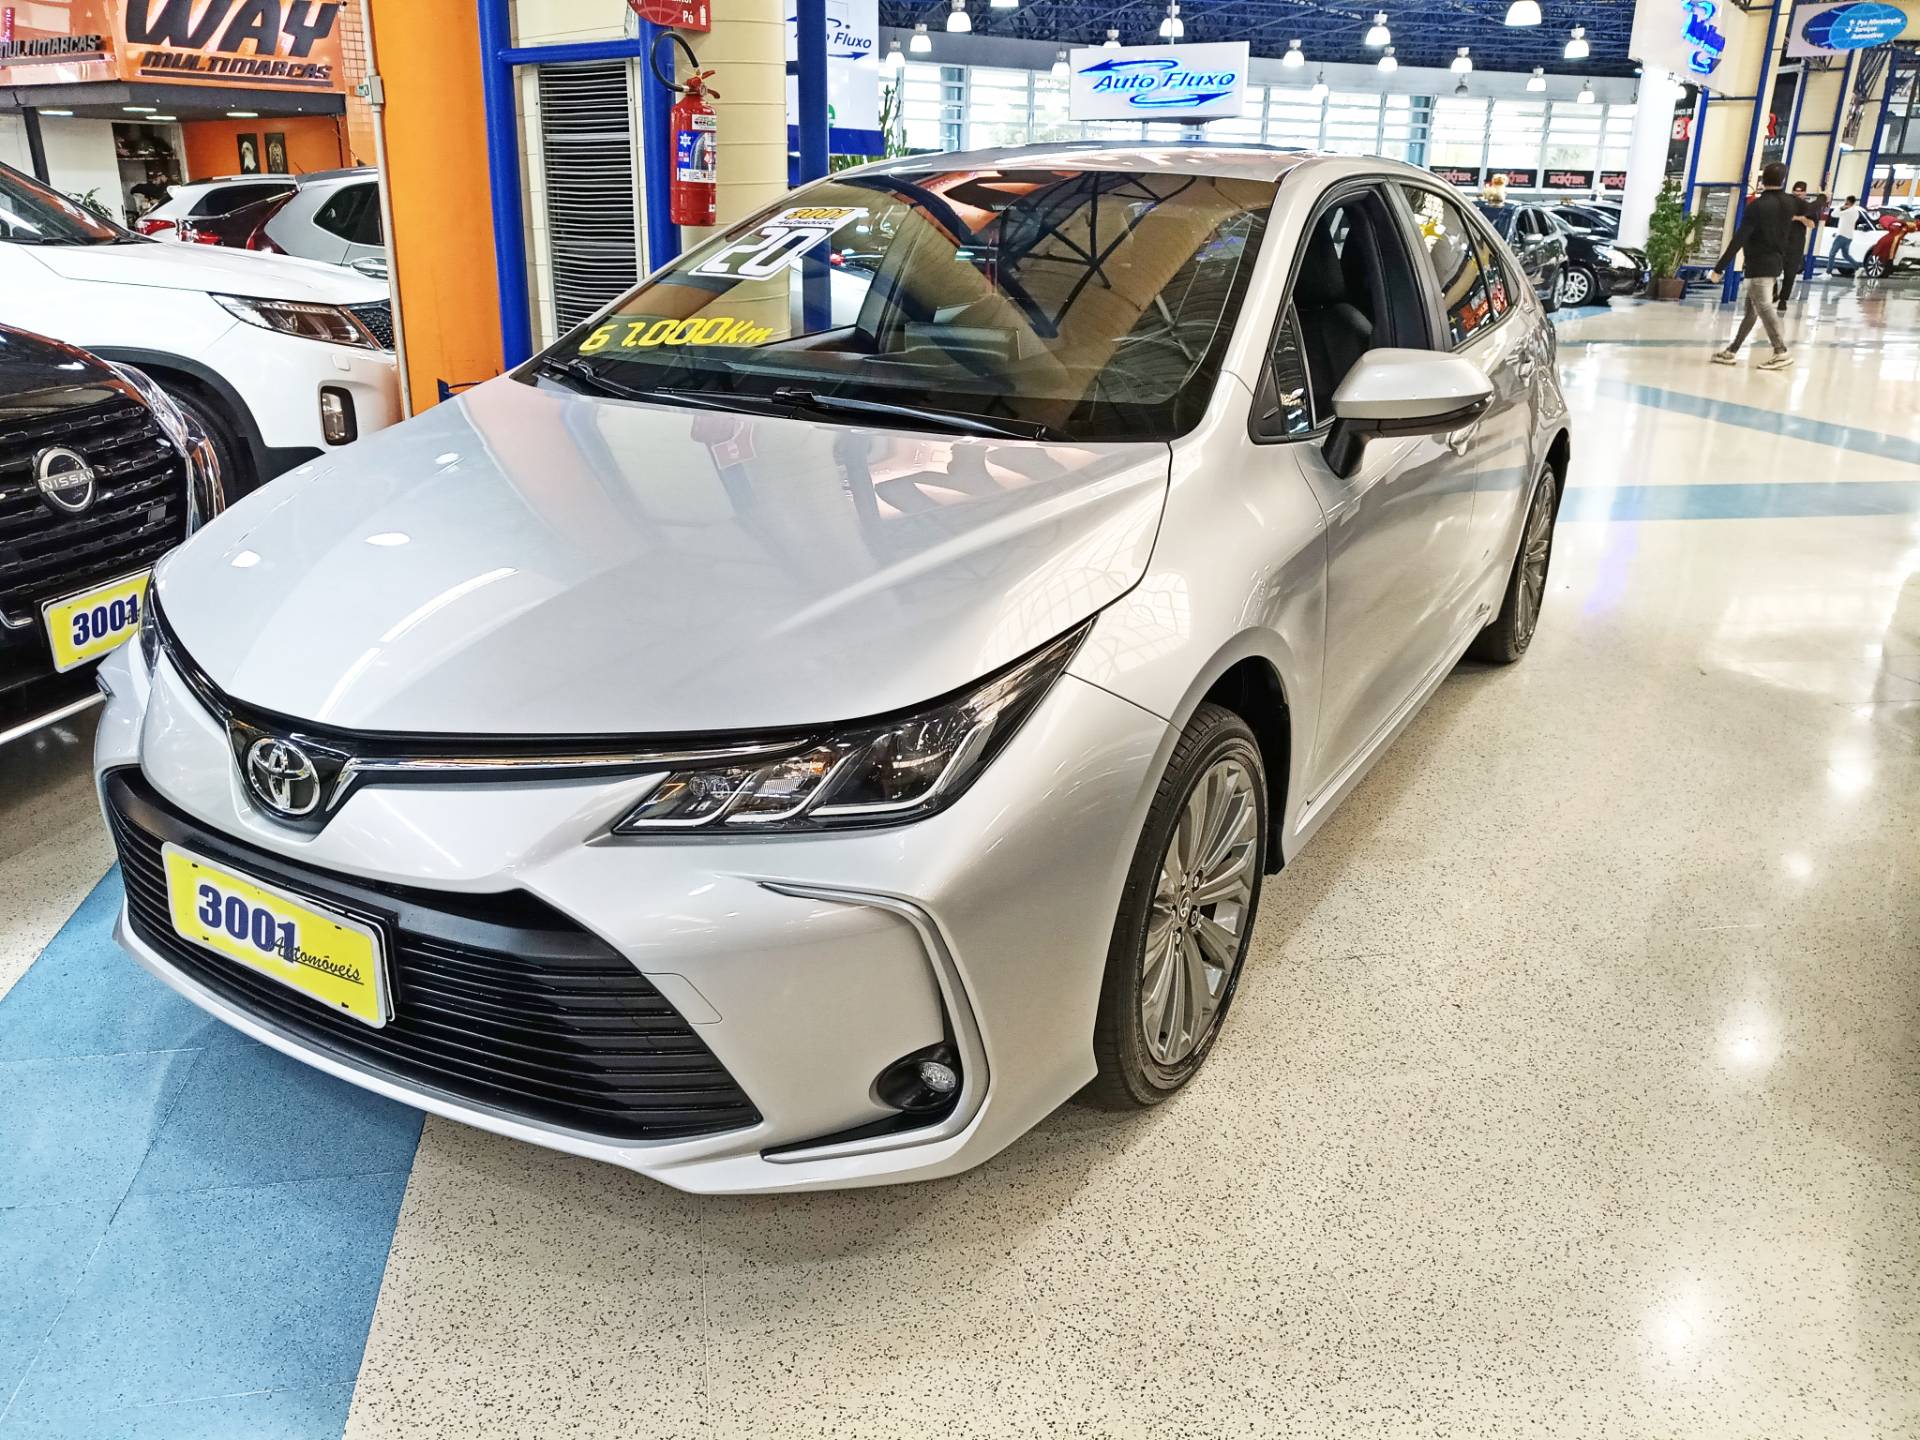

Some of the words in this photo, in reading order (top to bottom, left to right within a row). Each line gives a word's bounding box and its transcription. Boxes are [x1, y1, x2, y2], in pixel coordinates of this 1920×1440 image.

[126, 0, 339, 57] WAY
[682, 9, 694, 24] Pó
[834, 32, 872, 48] Fluxo
[141, 51, 333, 80] MULTIMARCAS
[1093, 73, 1156, 90] Auto
[1162, 71, 1236, 88] Fluxo
[698, 226, 834, 277] 20
[40, 467, 95, 492] NISSAN
[72, 594, 138, 647] 3001
[198, 884, 296, 964] 3001
